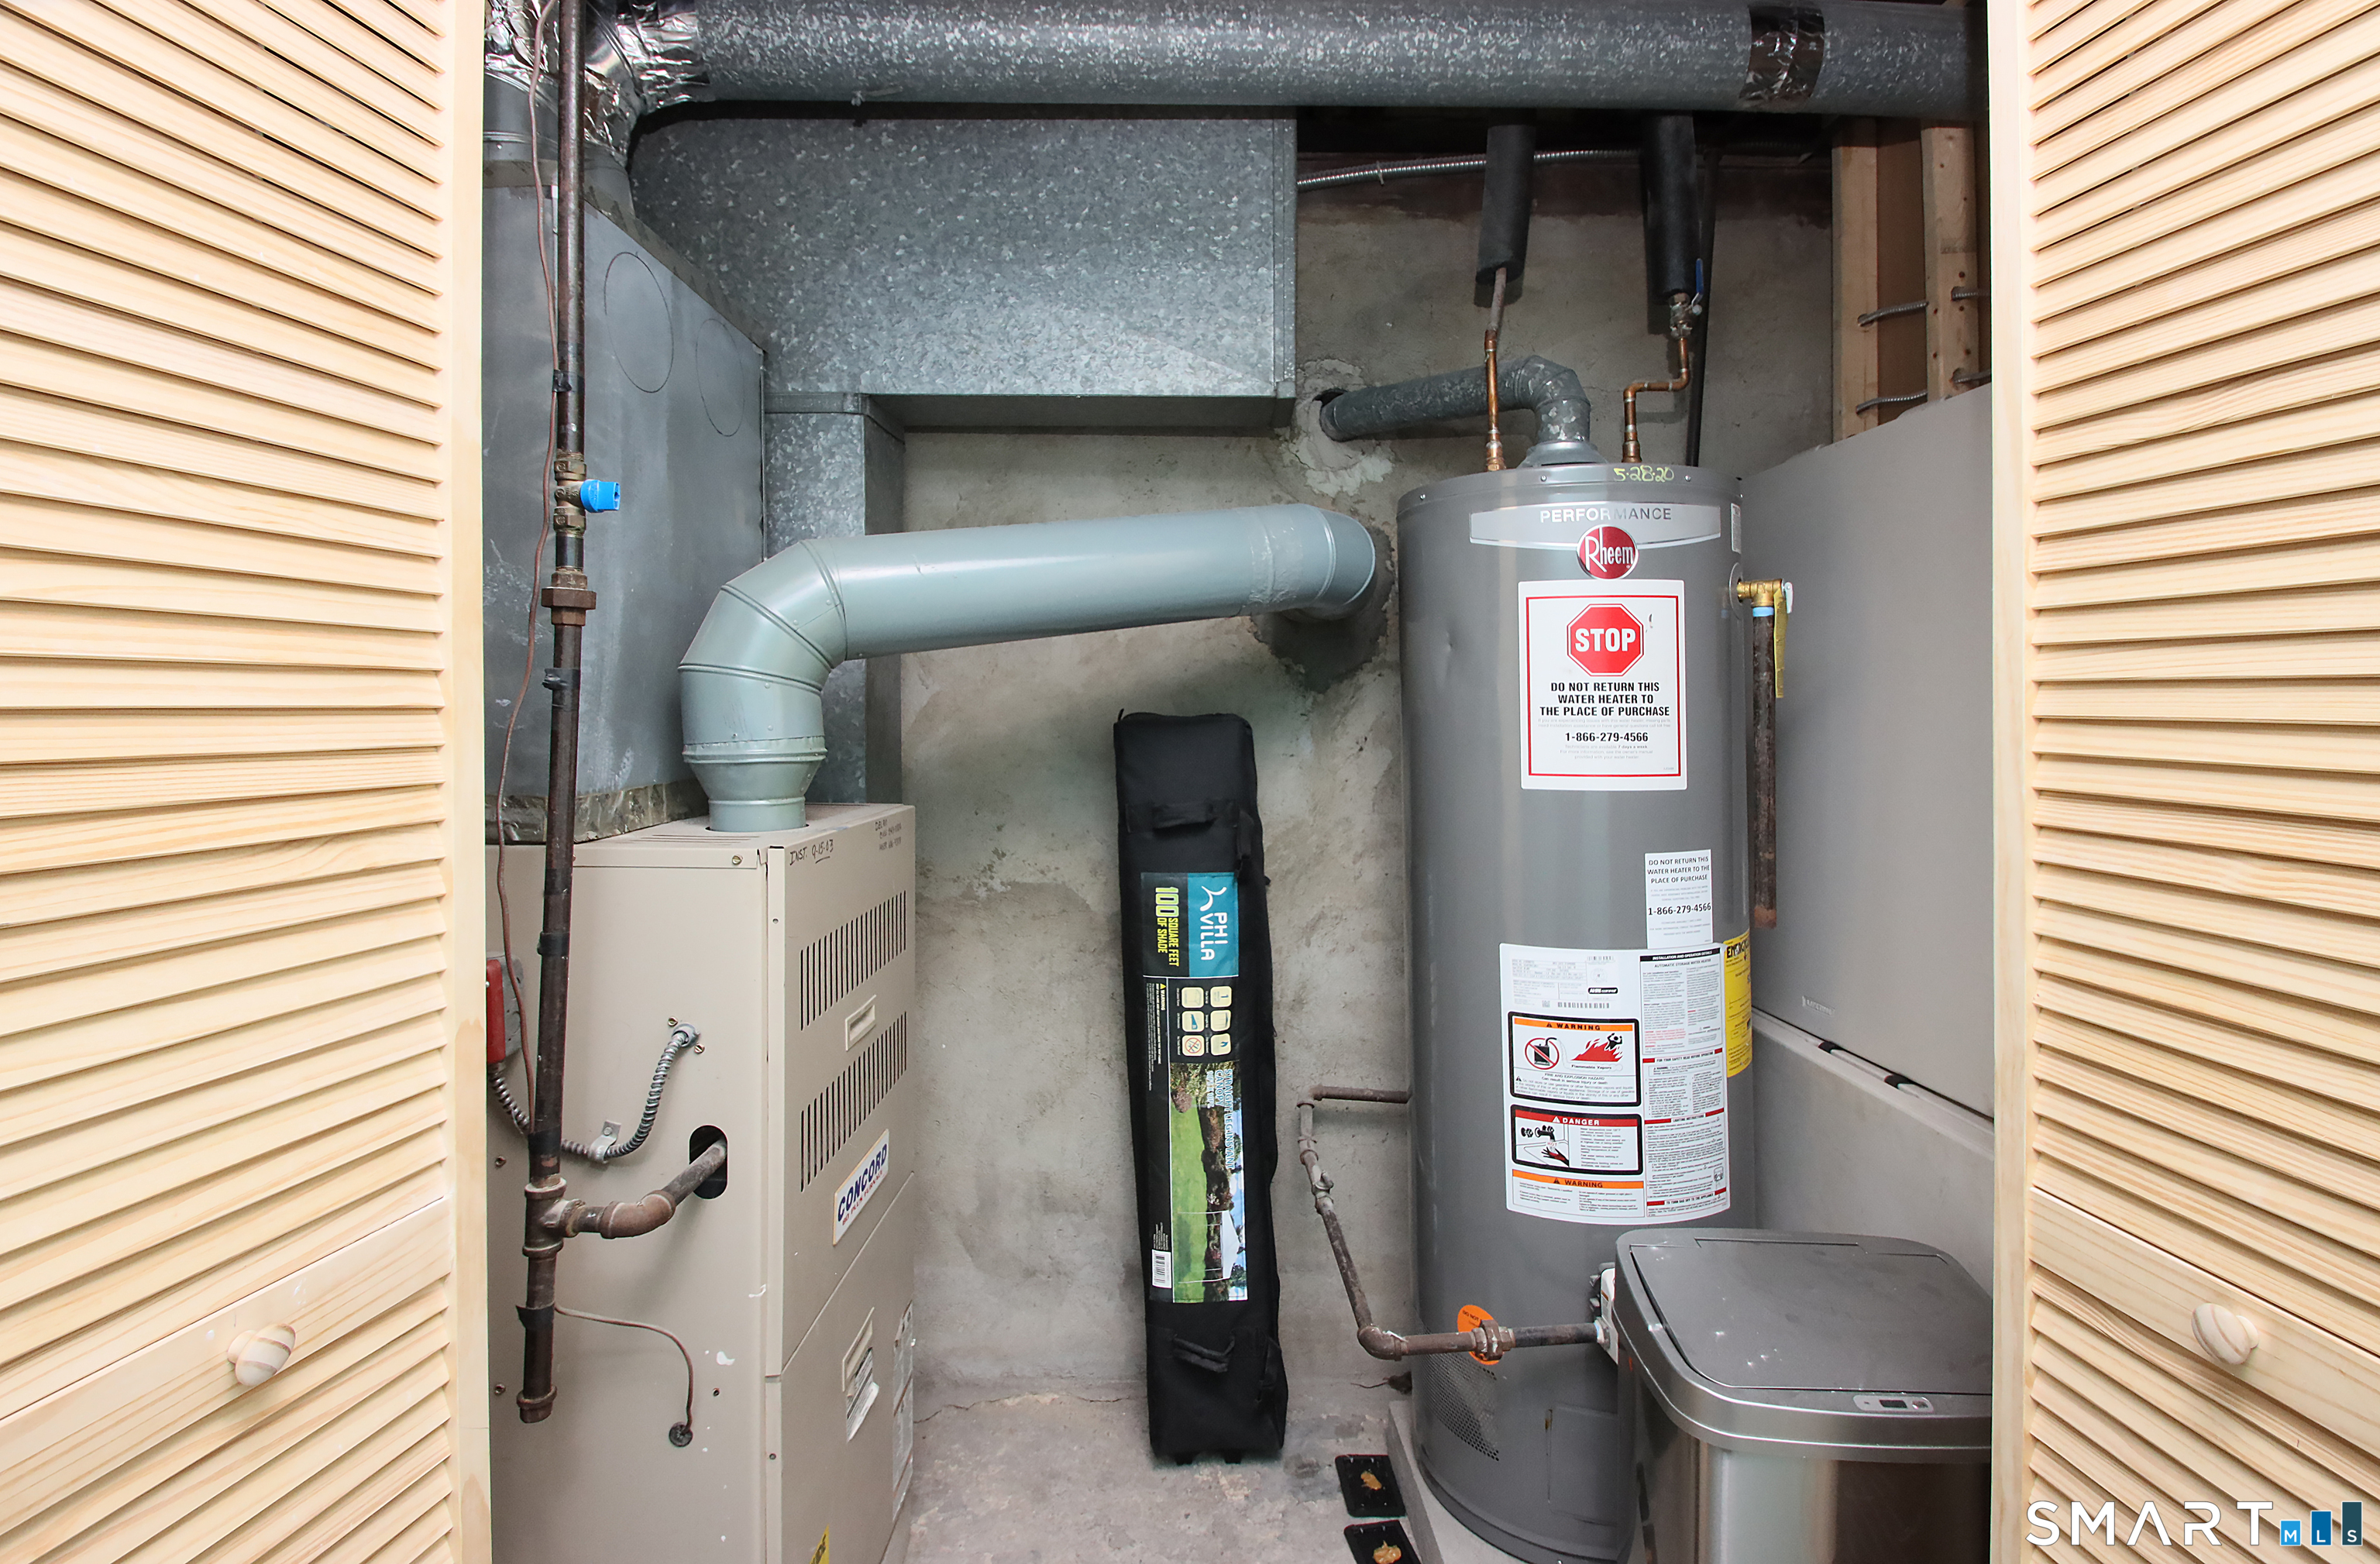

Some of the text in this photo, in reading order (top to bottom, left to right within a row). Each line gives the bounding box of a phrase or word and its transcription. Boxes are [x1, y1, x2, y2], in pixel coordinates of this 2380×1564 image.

[1540, 508, 1671, 523] PERFORMANCE
[1584, 527, 1633, 572] Rheem
[1575, 628, 1636, 652] STOP
[1551, 682, 1659, 692] DO NOT RETURN THIS
[1558, 694, 1654, 704] WATER HEATER TO
[1539, 706, 1670, 717] THE PLACE OF PURCHASE
[1565, 732, 1649, 742] 1-866-279-4566
[1155, 887, 1179, 917] 100
[1648, 902, 1711, 916] 1-866-279-4566
[1157, 918, 1168, 954] OF SHADE
[1200, 913, 1215, 960] VILLA
[1214, 913, 1229, 944] PHI
[1168, 918, 1179, 967] SQUARE FEET
[1215, 1070, 1225, 1106] CANOPY
[1224, 1069, 1235, 1170] STRAIGHT LEG INSTANT
[1562, 1117, 1601, 1126] DANGER
[838, 1143, 887, 1222] CONCORD
[1564, 1179, 1603, 1188] WARNING
